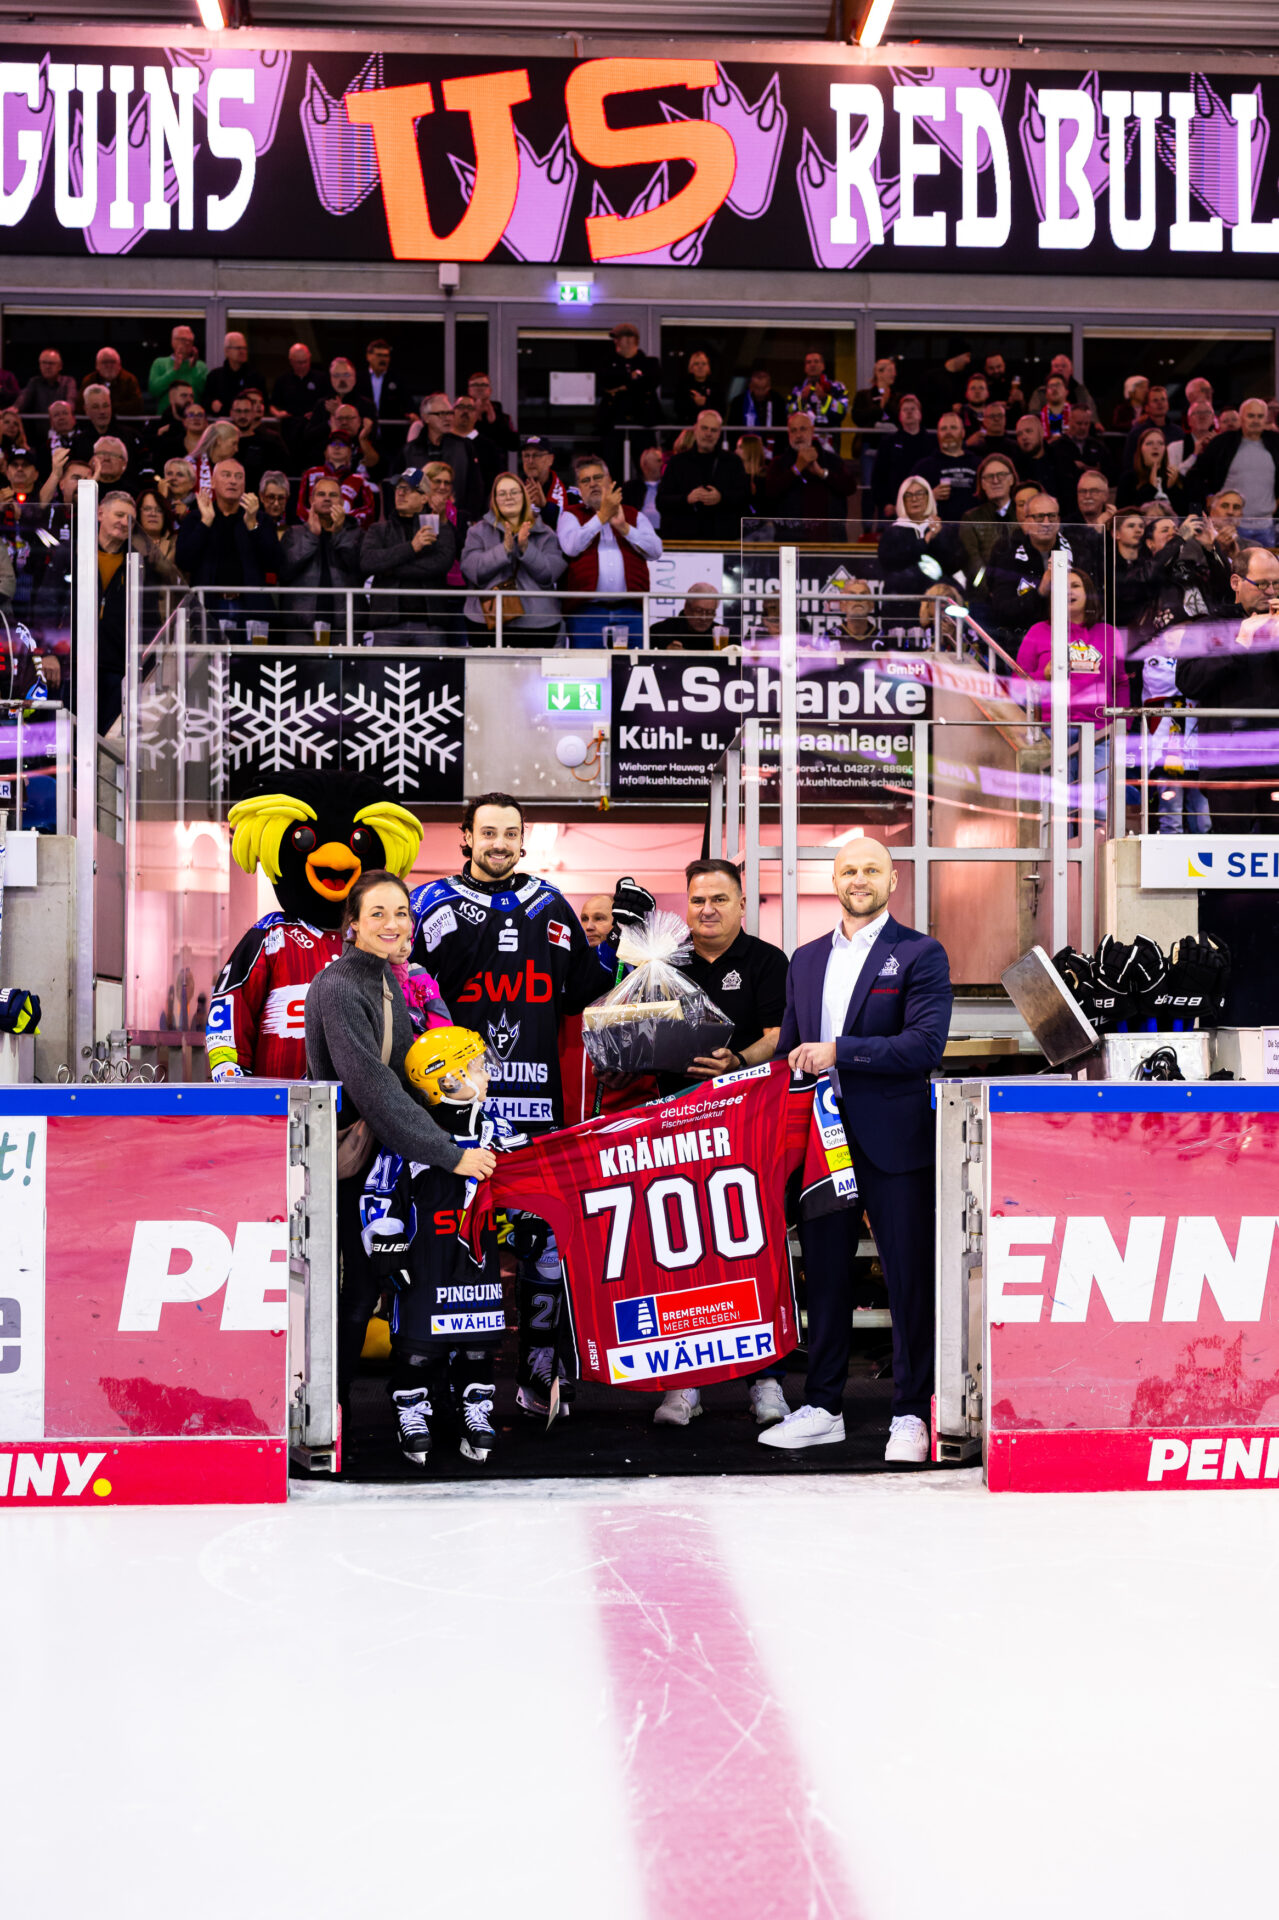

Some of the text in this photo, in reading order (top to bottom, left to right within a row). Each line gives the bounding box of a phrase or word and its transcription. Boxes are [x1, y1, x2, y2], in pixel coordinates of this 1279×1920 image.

[830, 83, 1011, 248] RED
[1038, 89, 1279, 252] BULL
[887, 663, 925, 675] GmbH
[620, 665, 927, 726] A.Schapke
[619, 725, 692, 750] Kühl-
[701, 733, 725, 750] u.
[619, 763, 667, 771] Wiehorner
[669, 763, 705, 773] Heuweg
[826, 765, 841, 773] Tel.
[844, 765, 875, 773] 04227
[1227, 851, 1279, 878] SEI
[458, 901, 487, 923] KSO
[501, 897, 509, 906] 21
[290, 928, 314, 949] KSO
[456, 959, 553, 1003] swb
[498, 1034, 508, 1049] P
[486, 1061, 548, 1083] GUINS
[482, 1098, 551, 1118] ÄHLER
[599, 1126, 731, 1178] KRÄMMER
[580, 1163, 768, 1284] 700
[117, 1220, 287, 1332] PE
[988, 1216, 1279, 1323] ENN
[436, 1283, 503, 1304] PINGUINS
[662, 1301, 734, 1321] BREMERHAVEN
[663, 1310, 741, 1332] MEER ERLEBEN!
[450, 1314, 505, 1331] WÄHLER
[645, 1332, 772, 1374] WÄHLER
[0, 1452, 112, 1497] NY.
